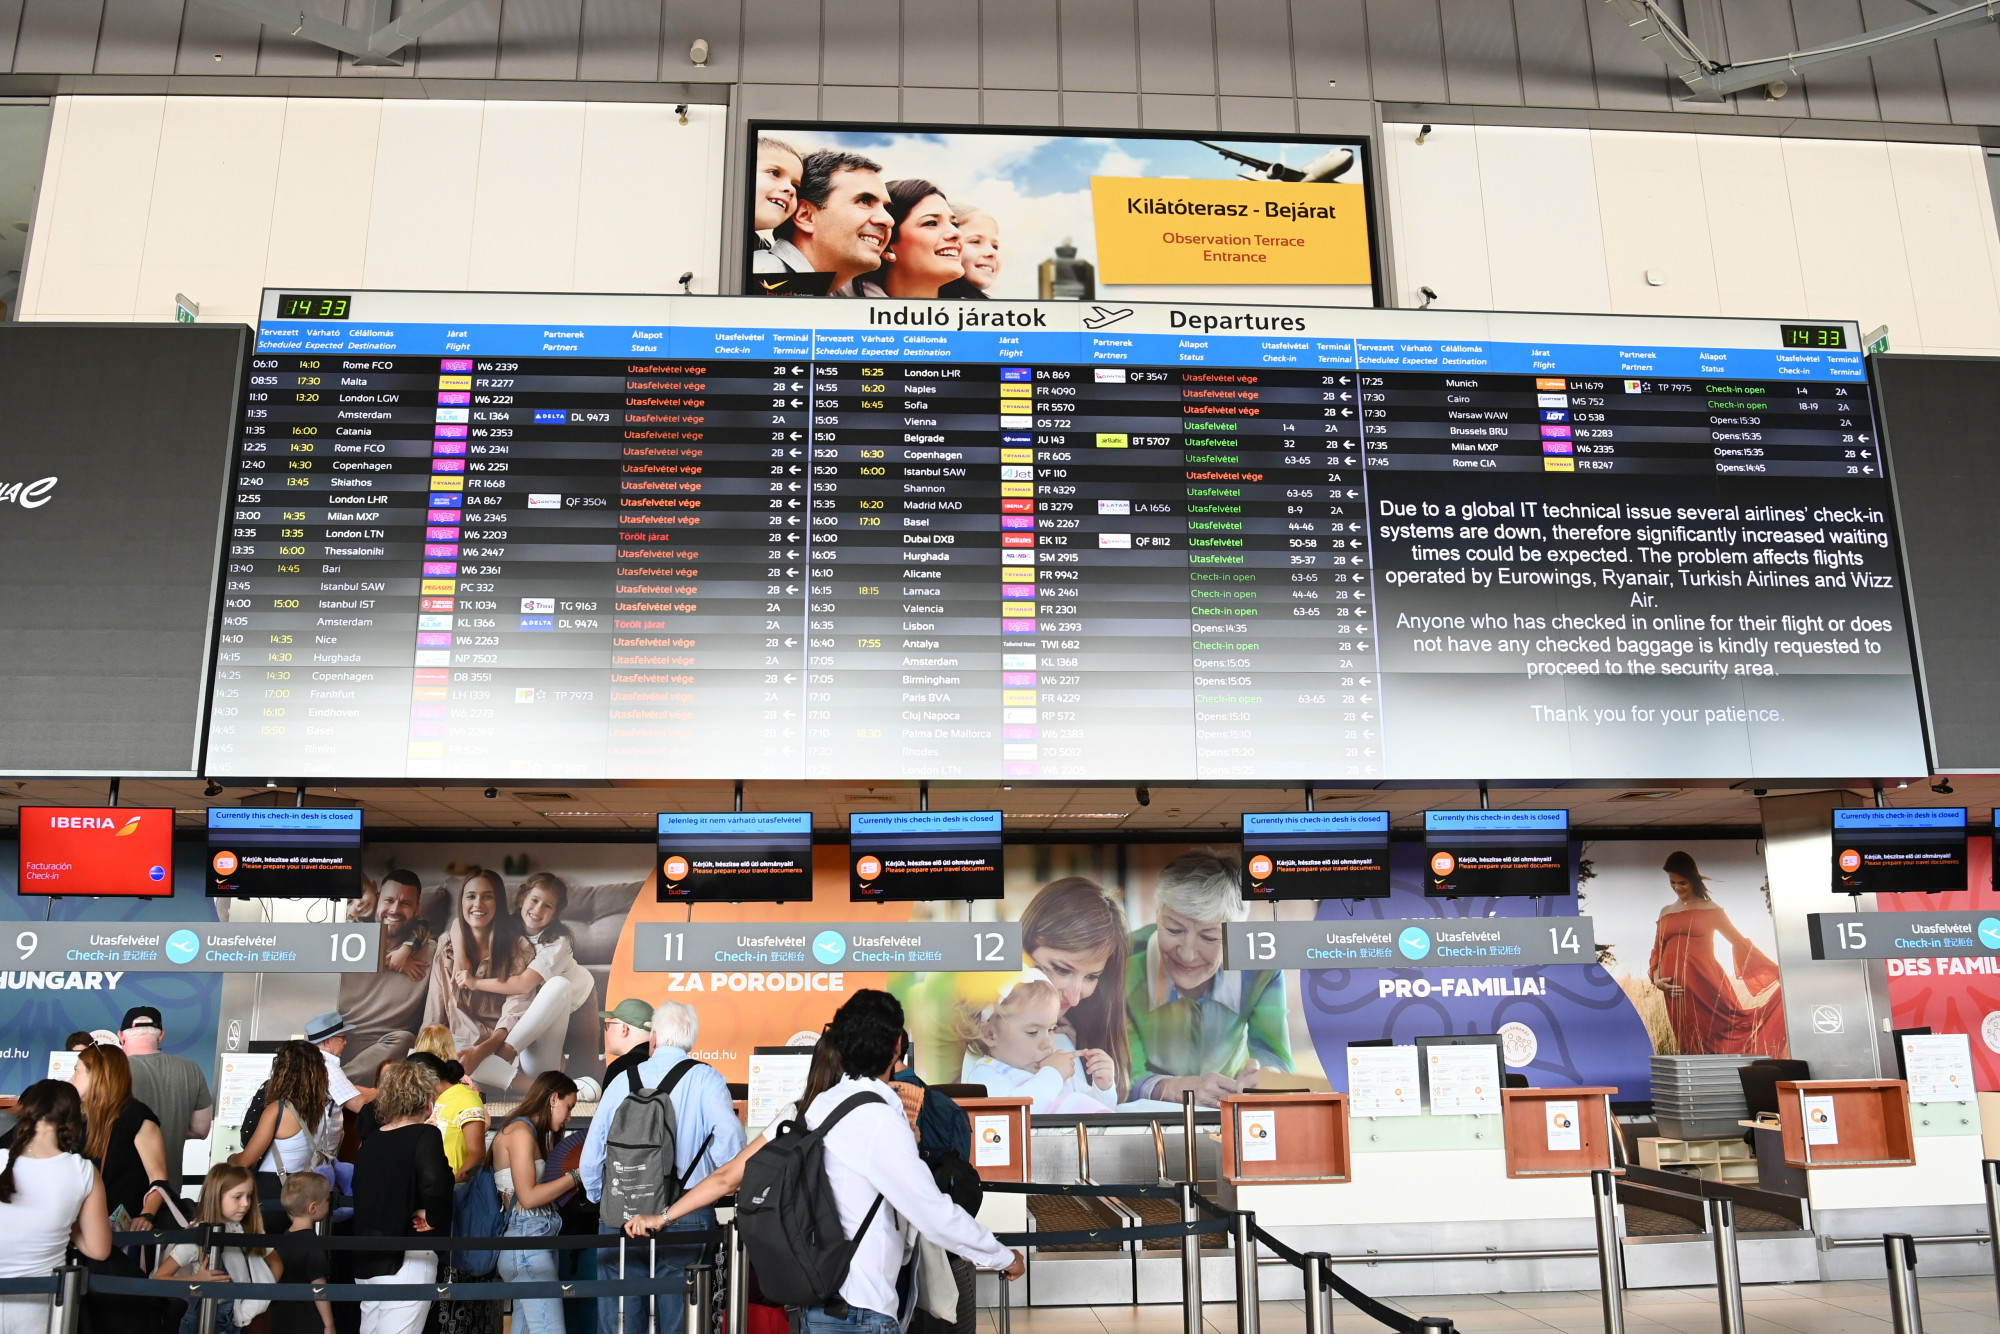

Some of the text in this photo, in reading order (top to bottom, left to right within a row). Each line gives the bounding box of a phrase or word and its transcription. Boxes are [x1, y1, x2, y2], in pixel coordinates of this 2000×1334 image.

[1128, 198, 1335, 221] Kilátóterasz Bejárat
[1163, 232, 1304, 246] Observation Terrace
[1203, 250, 1266, 262] Entrance
[870, 307, 1306, 333] Induló járatok Departures
[258, 340, 302, 348] Scheduled
[446, 343, 470, 351] Flight
[632, 330, 662, 339] Állapot
[715, 333, 764, 341] Utasfelvétel
[253, 360, 278, 368] 06:10
[343, 361, 369, 369] Rome
[372, 361, 392, 369] FCO
[628, 365, 681, 373] Utasfelvétel
[684, 366, 706, 375] vége
[816, 367, 838, 375] 14:55
[862, 368, 883, 376] 15:25
[904, 369, 938, 377] London
[1130, 372, 1144, 381] QF
[1147, 372, 1167, 380] 3547
[1236, 375, 1257, 384] vége
[1322, 376, 1333, 384] 2B
[1362, 377, 1383, 385] 17:25
[1446, 379, 1477, 387] Munich
[1706, 385, 1742, 393] Check-in
[1380, 500, 1416, 515] Due
[1422, 501, 1439, 516] to
[1445, 505, 1456, 516] a
[1462, 501, 1514, 520] global
[1521, 502, 1537, 517] IT
[1542, 503, 1620, 518] technical
[1626, 504, 1671, 519] issue
[1677, 505, 1739, 520] several
[1814, 507, 1883, 522] check-in
[1380, 523, 1888, 547] systems are down, therefore significantly increased waiting
[1411, 545, 1863, 568] times could be expected. The problem affects flights
[1386, 567, 1893, 588] operated by Eurowings, Ryanair, Turkish Airlines and Wizz
[1630, 592, 1657, 607] Air.
[1396, 613, 1892, 634] Anyone who has checked in online for their flight or does
[1414, 636, 1880, 657] not have any checked baggage is kindly requested to
[1527, 660, 1779, 680] proceed to the security area.
[1531, 705, 1785, 726] Thank you for your patience.
[51, 817, 114, 828] IBERIA
[27, 862, 71, 870] Facturación
[1837, 922, 1866, 949] 15
[1912, 923, 1971, 933] Utasfelvétel
[16, 932, 37, 960] 9
[90, 935, 159, 945] Utasfelvétel
[330, 933, 365, 961] 10
[664, 933, 683, 960] 11
[974, 933, 1004, 960] 12
[1246, 932, 1275, 959] 13
[1895, 938, 1941, 948] Check-in
[66, 949, 119, 961] Check-in
[1887, 958, 1932, 976] DES
[668, 973, 844, 991] ZA PORODICE
[1380, 977, 1547, 997] PRO-FAMILIA!
